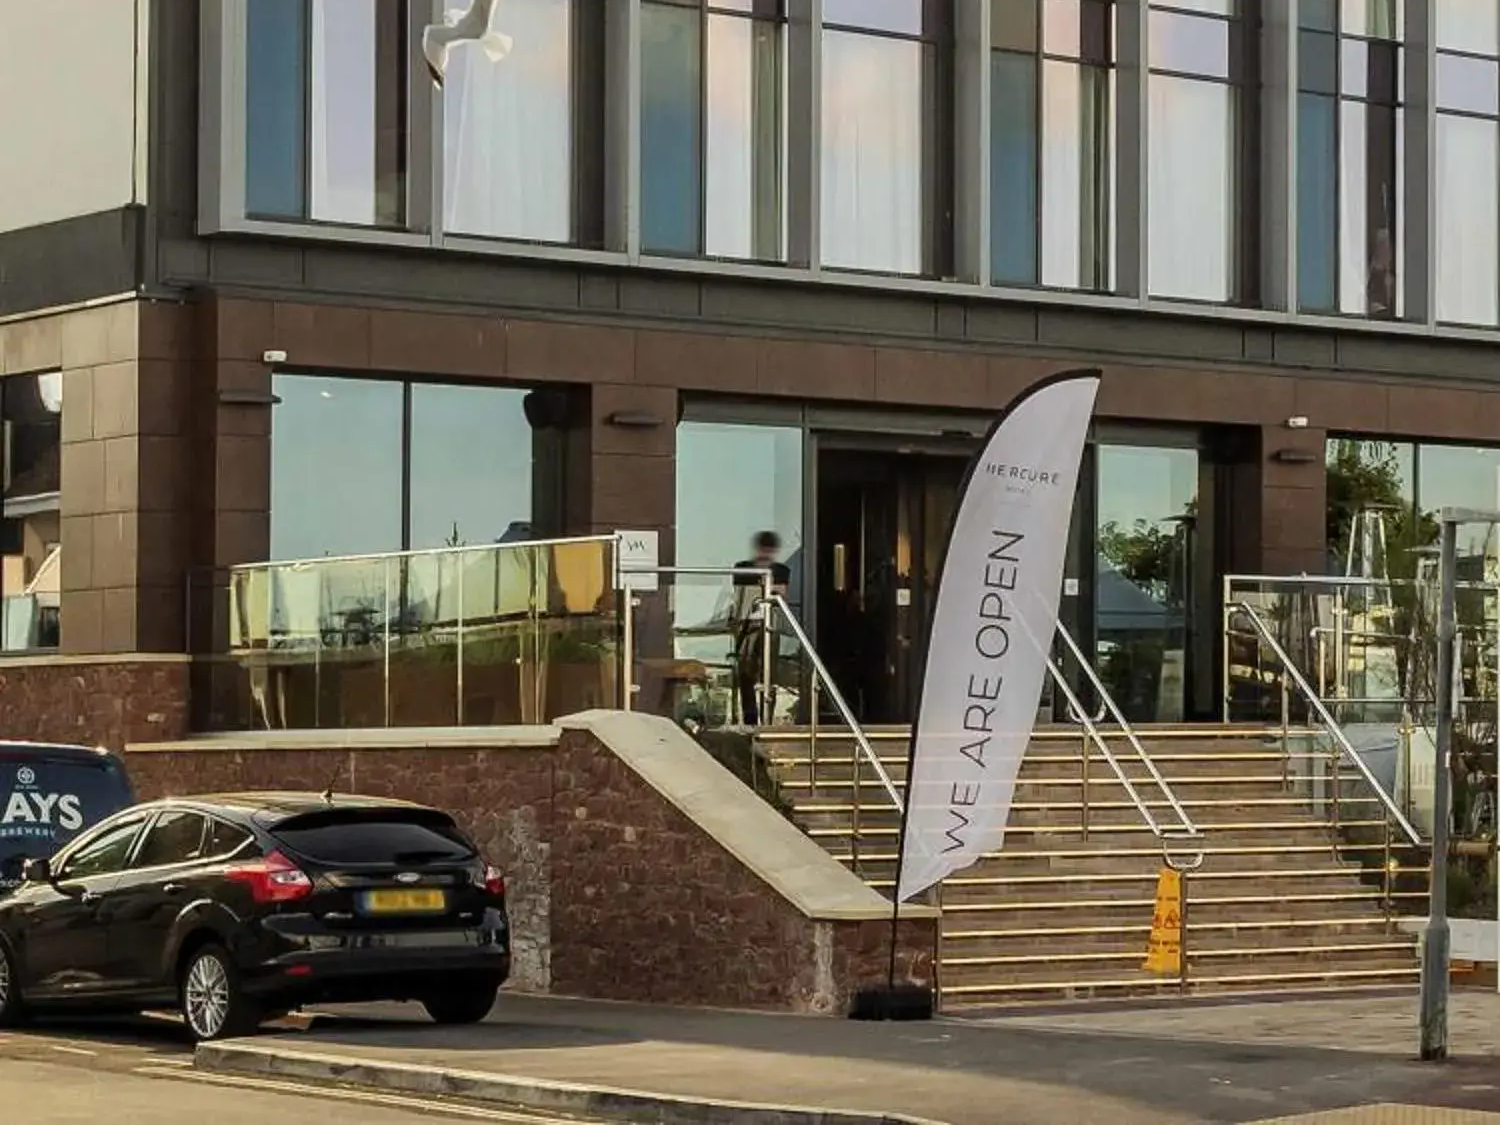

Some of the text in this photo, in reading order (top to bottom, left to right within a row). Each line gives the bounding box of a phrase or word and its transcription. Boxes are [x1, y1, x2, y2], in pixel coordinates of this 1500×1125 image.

[985, 462, 1059, 484] MERCURE
[975, 529, 1025, 660] OPEN
[959, 673, 1003, 769] ARE
[1, 792, 83, 830] AYS
[941, 781, 981, 855] WE
